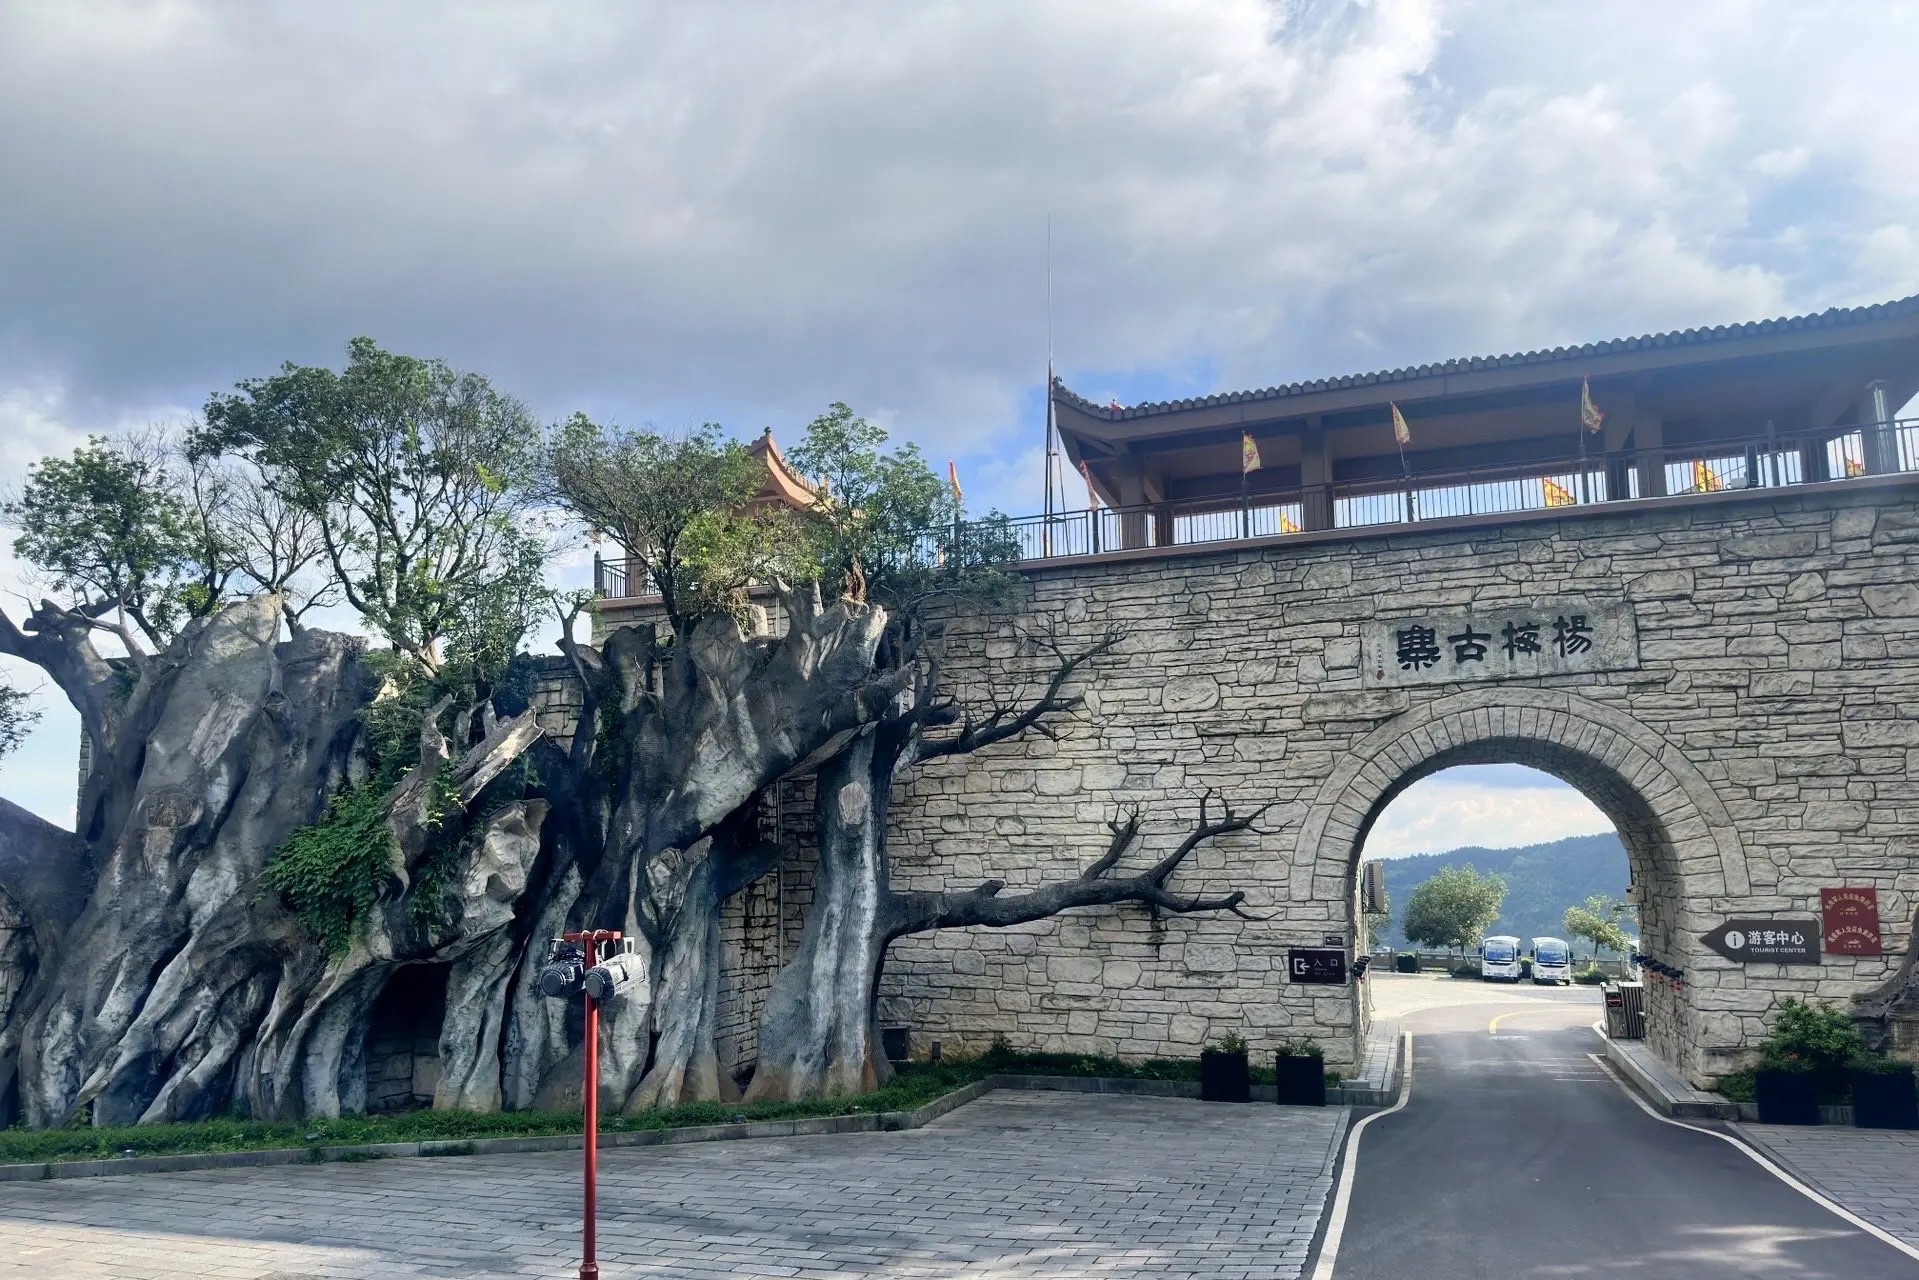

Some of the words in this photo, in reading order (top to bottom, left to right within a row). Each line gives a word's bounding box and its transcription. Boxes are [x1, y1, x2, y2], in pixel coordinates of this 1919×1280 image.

[1748, 930, 1805, 945] 游客中心
[1314, 958, 1338, 967] 入口
